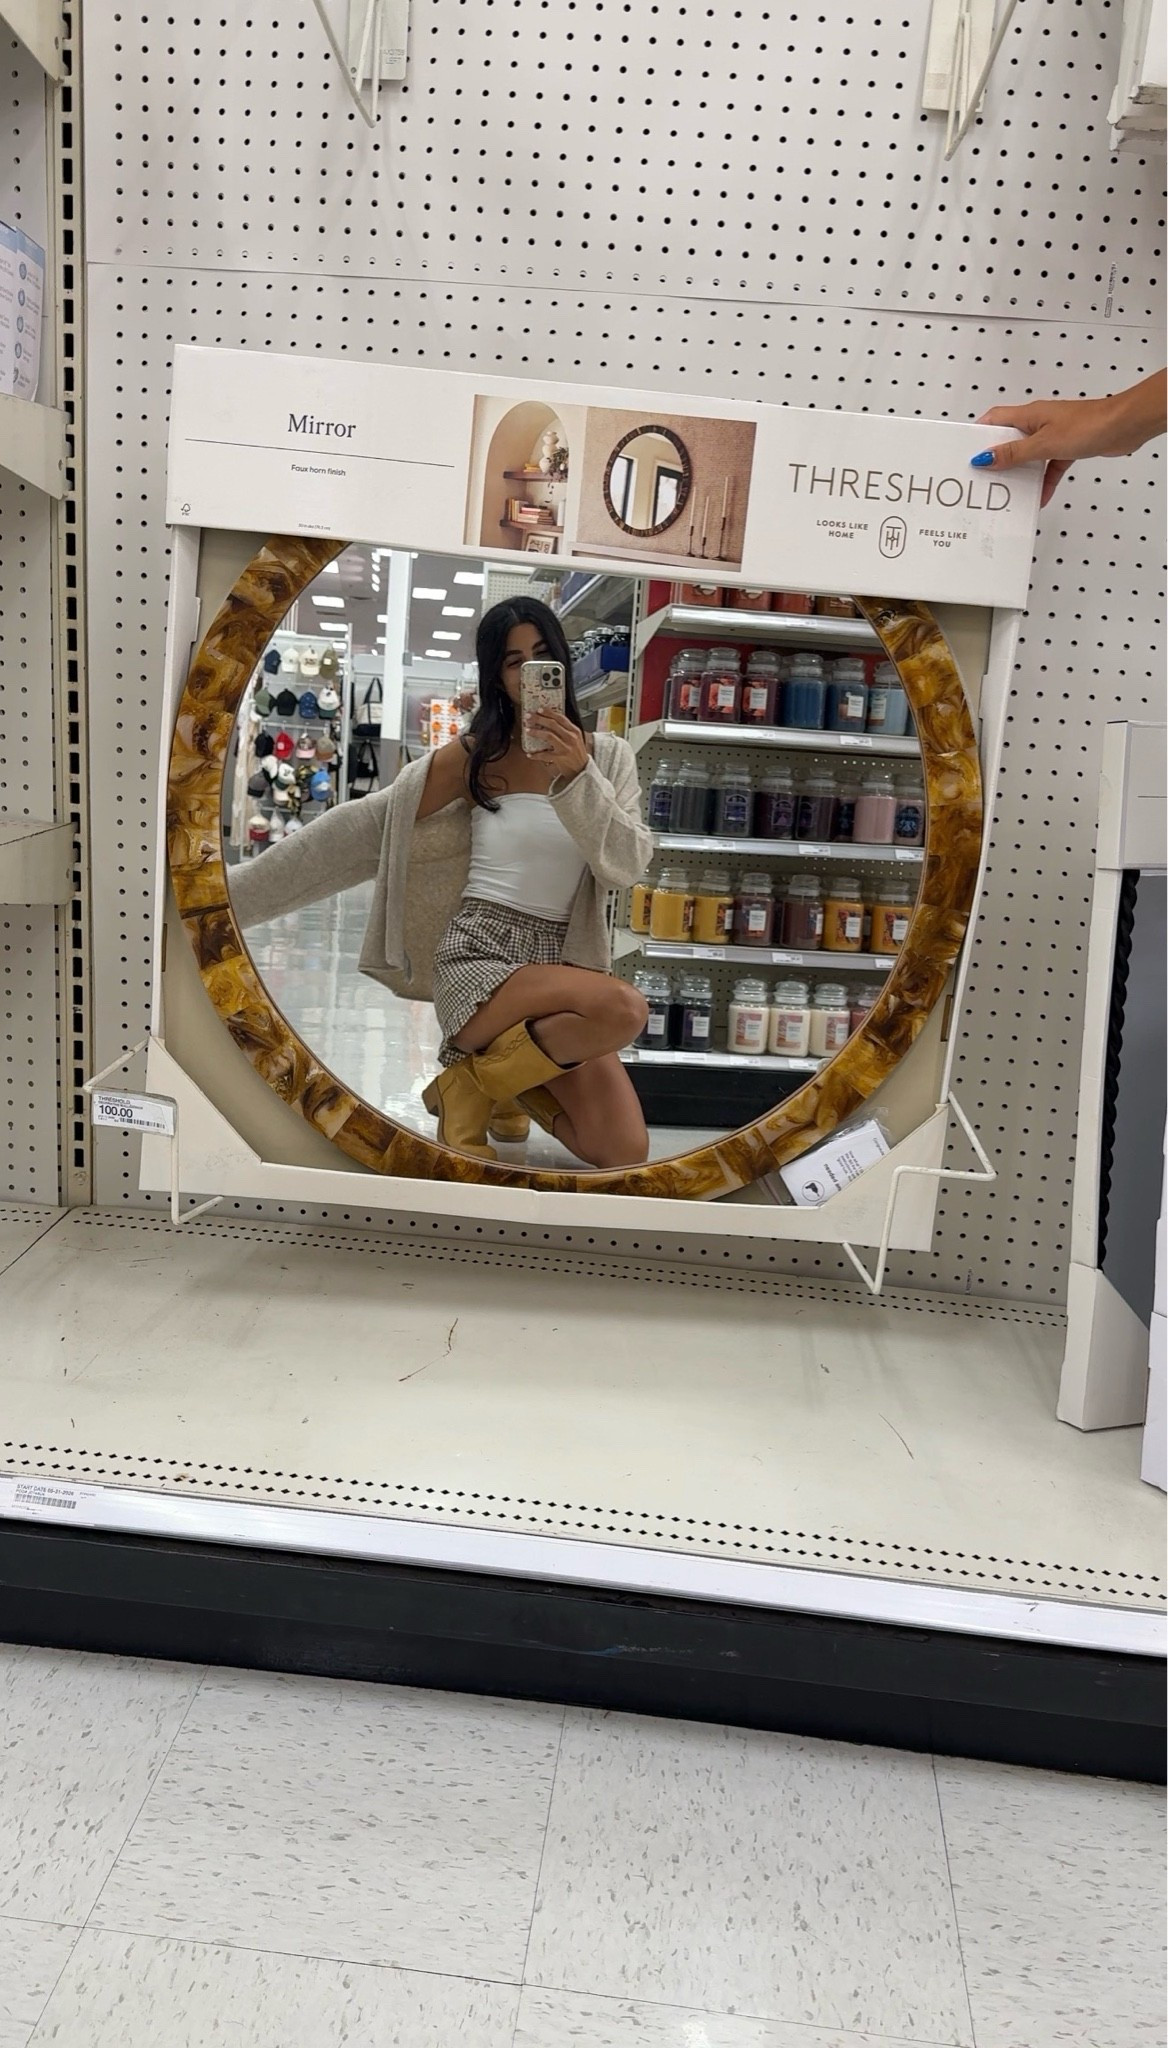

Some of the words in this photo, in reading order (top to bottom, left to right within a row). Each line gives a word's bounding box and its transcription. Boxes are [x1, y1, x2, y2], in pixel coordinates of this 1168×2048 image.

[288, 413, 357, 438] Mirror
[291, 464, 308, 473] Faux
[309, 466, 326, 474] horn
[327, 467, 346, 477] finish
[789, 463, 1011, 511] THRESHOLD
[816, 519, 846, 529] LOOKS
[849, 522, 869, 531] LIKE
[828, 530, 854, 539] HOME
[919, 529, 945, 538] FEELS
[947, 531, 967, 540] LIKE
[933, 539, 951, 548] YOU
[98, 1095, 131, 1104] THRESHOLD
[99, 1104, 133, 1118] 100.00
